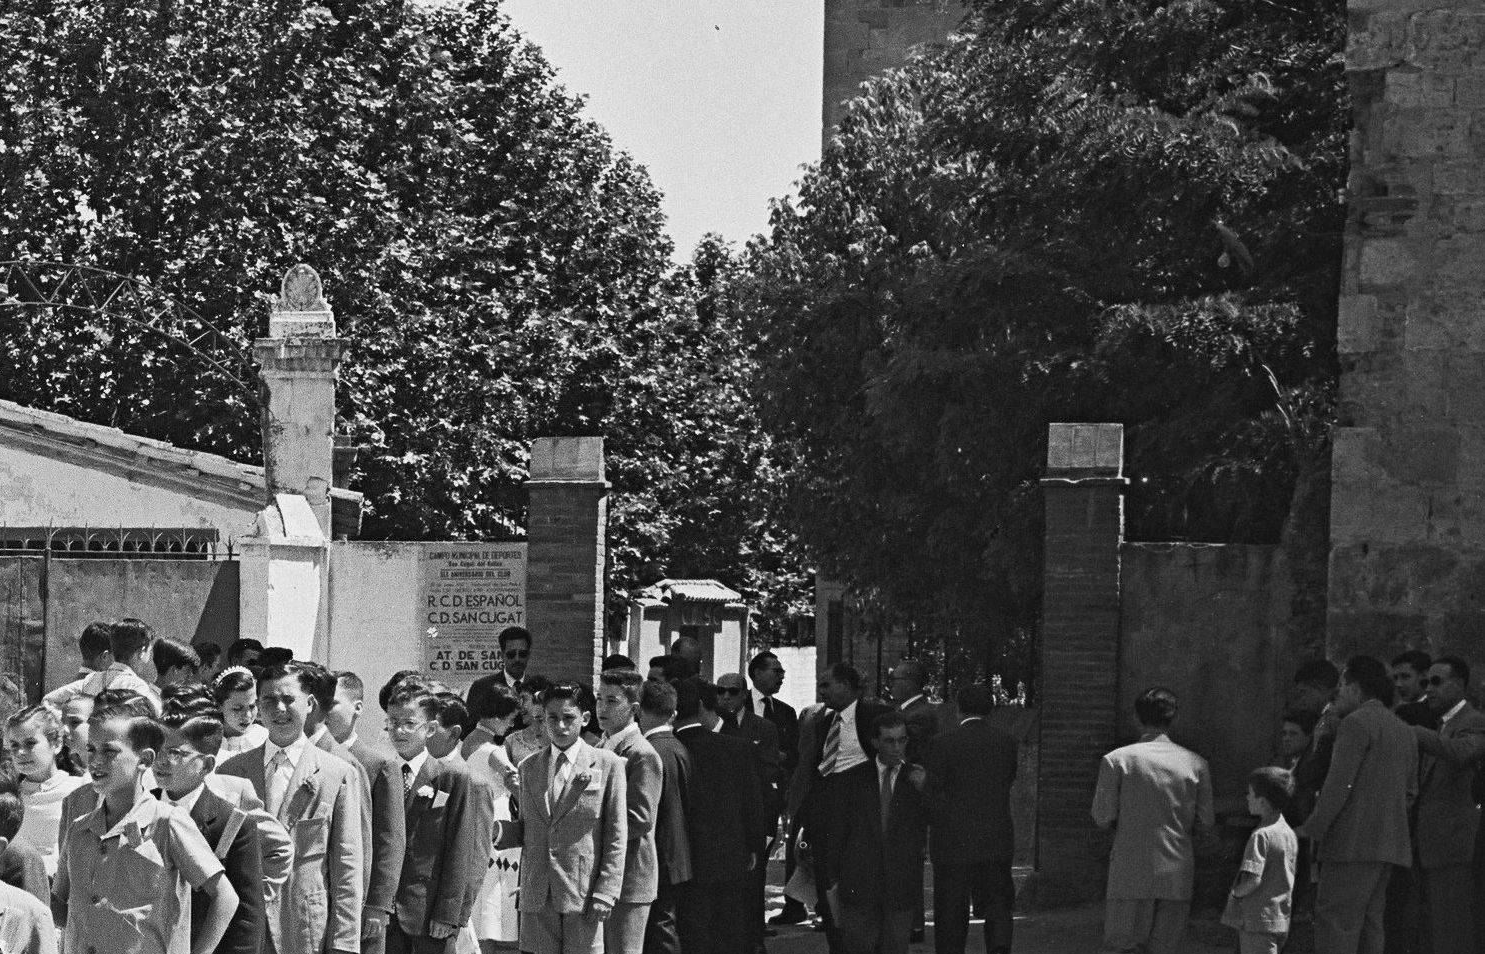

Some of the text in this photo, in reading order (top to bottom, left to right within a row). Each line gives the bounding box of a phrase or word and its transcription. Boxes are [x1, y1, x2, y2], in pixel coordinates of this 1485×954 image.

[466, 594, 523, 607] ESPAÑOL
[458, 651, 475, 660] DE
[455, 661, 479, 671] SAN
[482, 661, 506, 671] CUG
